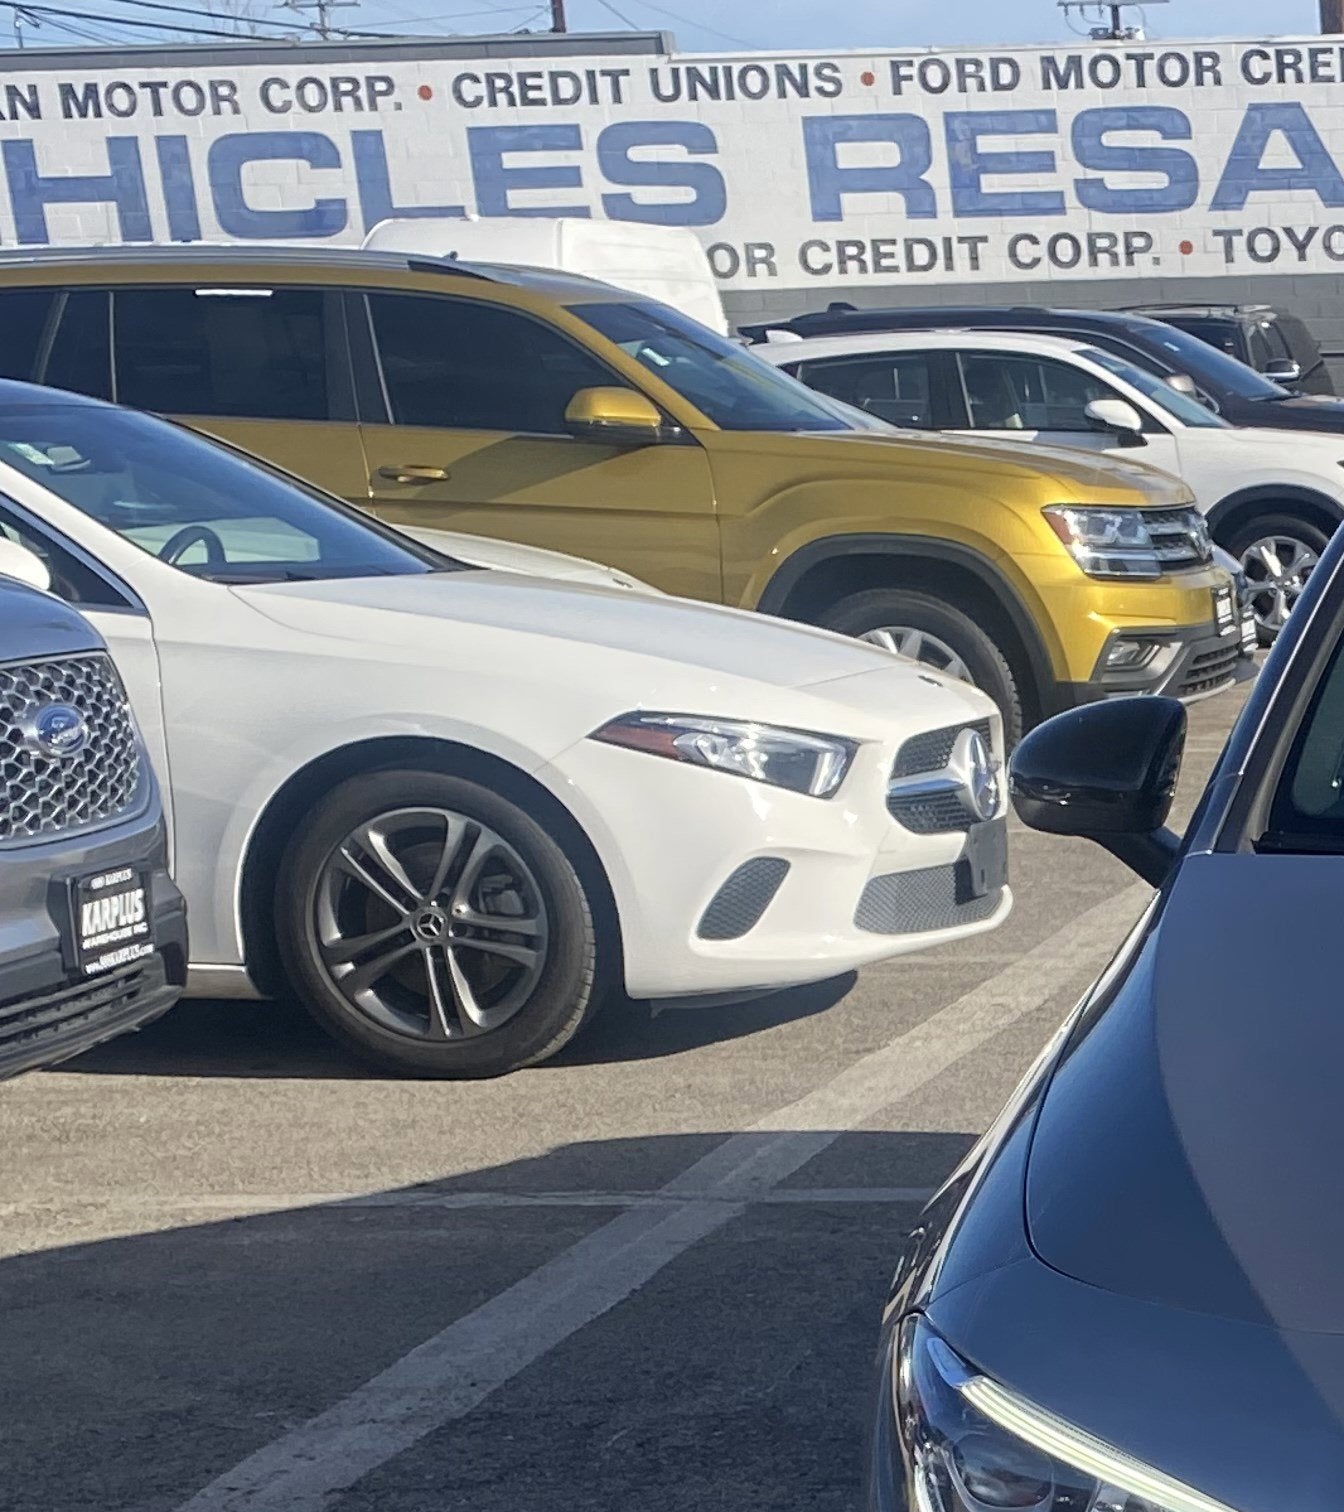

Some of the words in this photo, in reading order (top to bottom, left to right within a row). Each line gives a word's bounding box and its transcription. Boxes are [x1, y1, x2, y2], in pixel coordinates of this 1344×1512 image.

[59, 80, 240, 119] MOTOR
[260, 76, 402, 113] CORP.
[453, 69, 629, 108] CREDIT
[650, 63, 842, 102] UNIONS
[890, 58, 1020, 95] FORD
[1041, 52, 1221, 90] MOTOR
[800, 236, 988, 275] CREDIT
[1008, 231, 1161, 269] CORP.
[82, 889, 145, 937] KARPLUS
